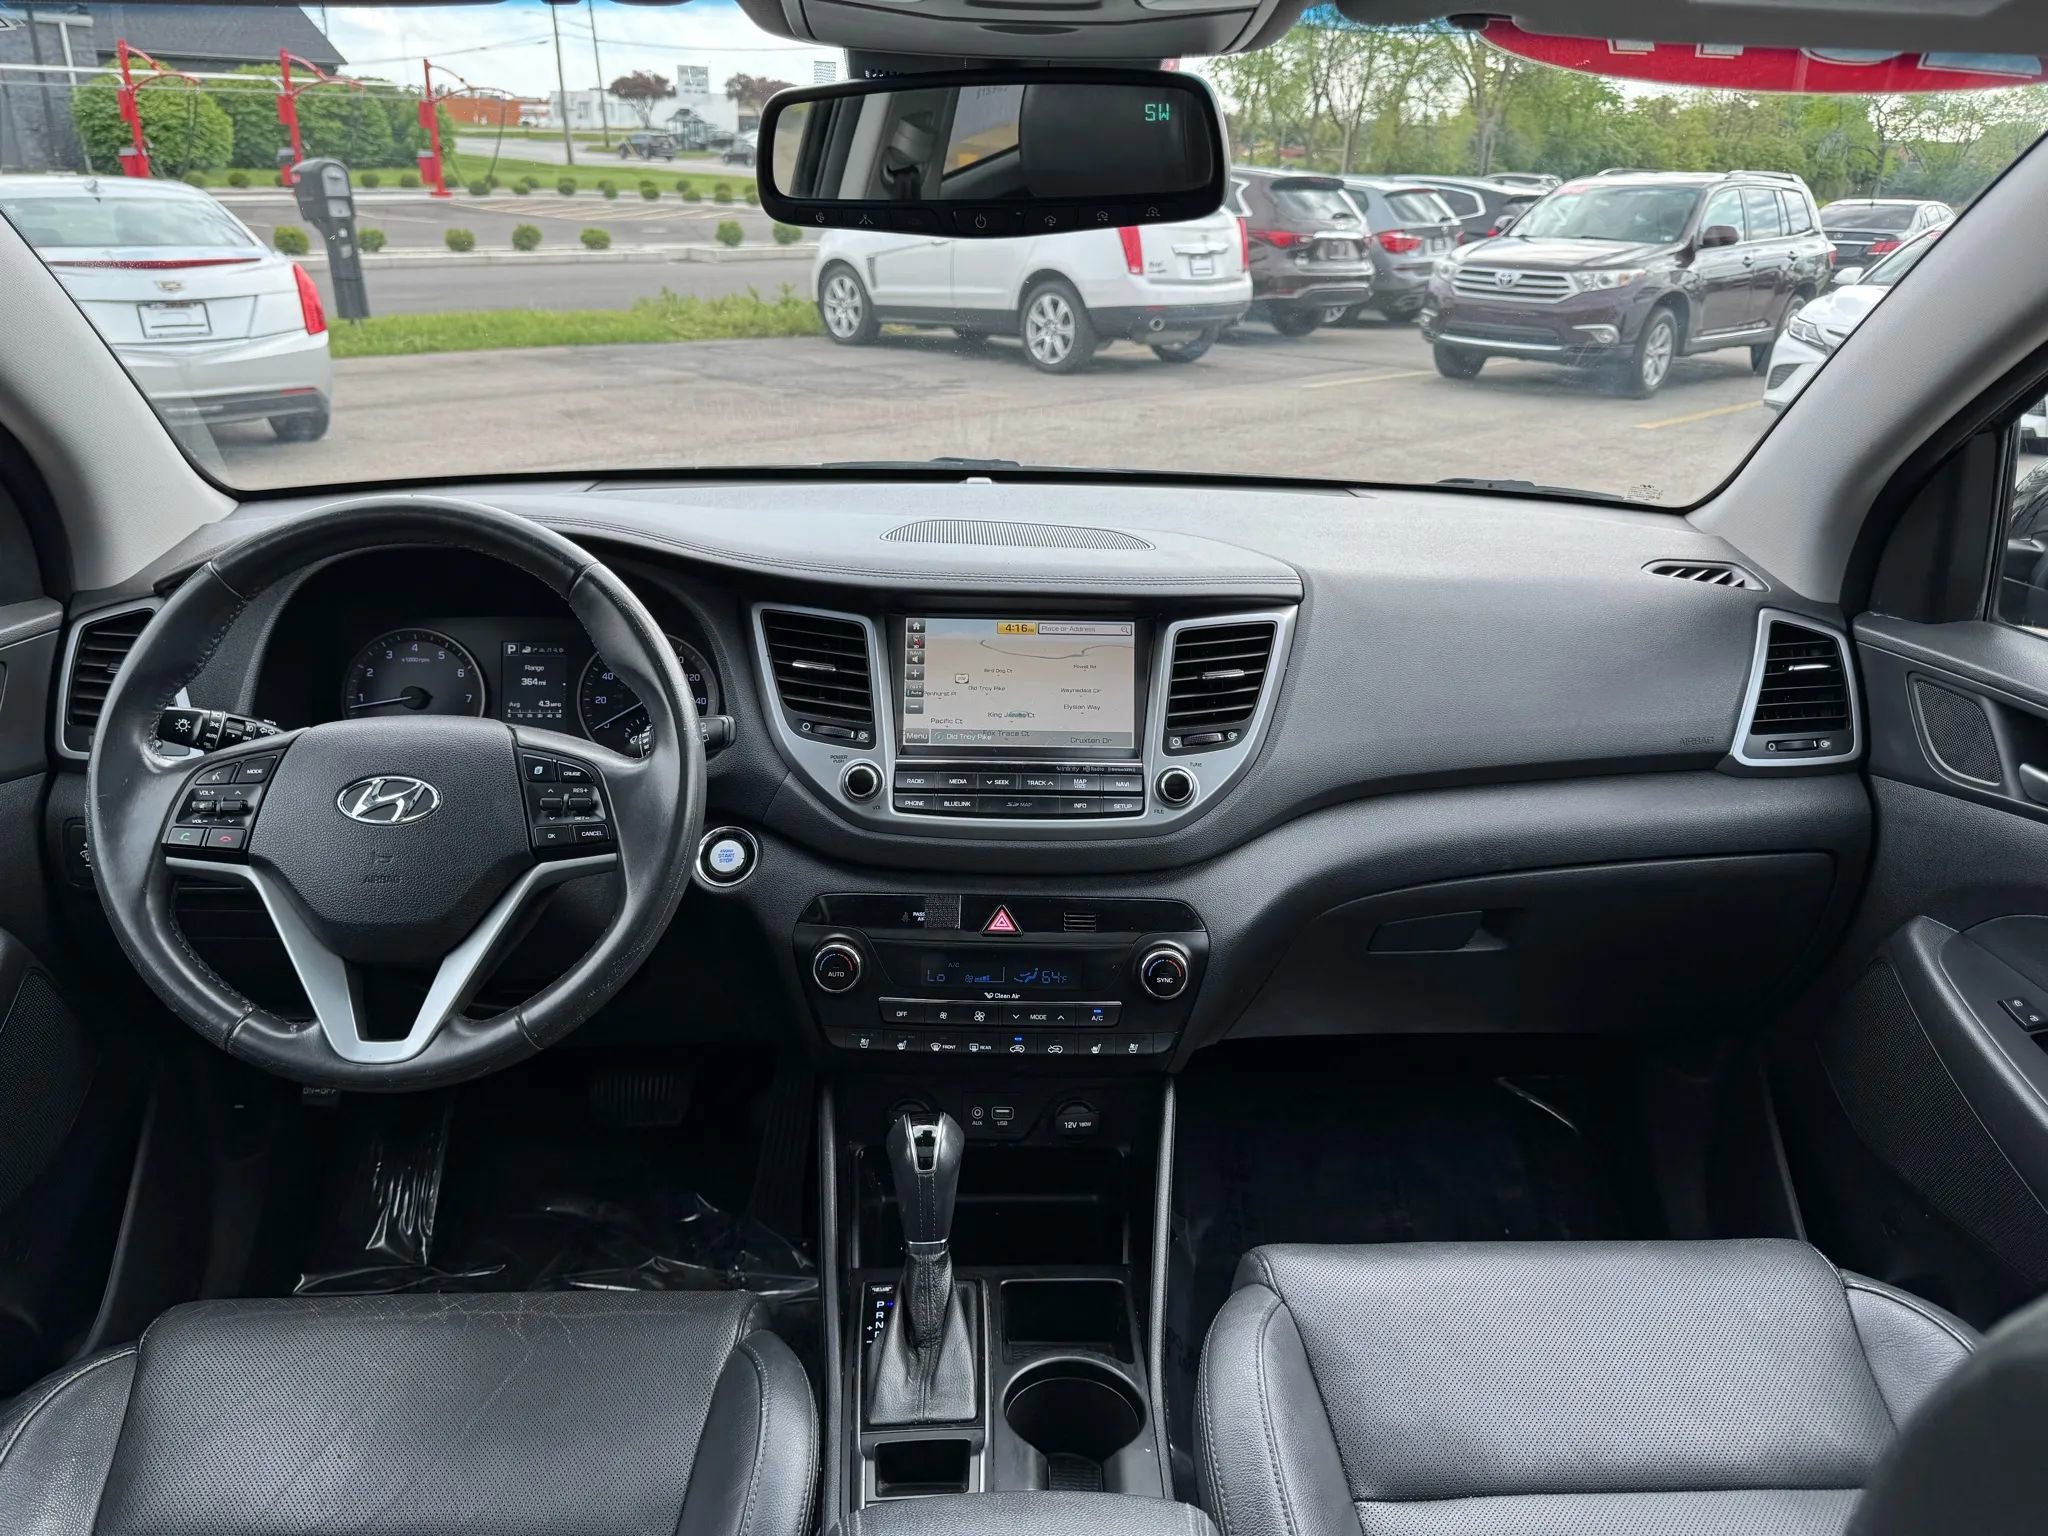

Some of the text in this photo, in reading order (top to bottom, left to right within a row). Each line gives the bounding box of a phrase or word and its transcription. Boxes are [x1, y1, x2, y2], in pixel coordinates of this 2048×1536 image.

[1144, 103, 1171, 121] SW
[1005, 623, 1028, 632] 4:16
[411, 643, 419, 652] 4
[507, 644, 517, 655] P
[385, 650, 393, 659] 3
[438, 650, 446, 660] 5
[366, 668, 374, 677] 2
[524, 664, 545, 672] Range
[457, 668, 465, 678] 6
[601, 672, 614, 680] 40
[521, 677, 538, 686] 364
[358, 693, 364, 702] 1
[465, 694, 473, 703] 7
[595, 696, 607, 704] 20
[695, 697, 707, 705] 40
[906, 732, 928, 740] Menu
[959, 733, 976, 741] Troy
[1064, 1121, 1078, 1129] 12V
[876, 1300, 885, 1309] P
[875, 1311, 885, 1319] R
[875, 1320, 884, 1329] N
